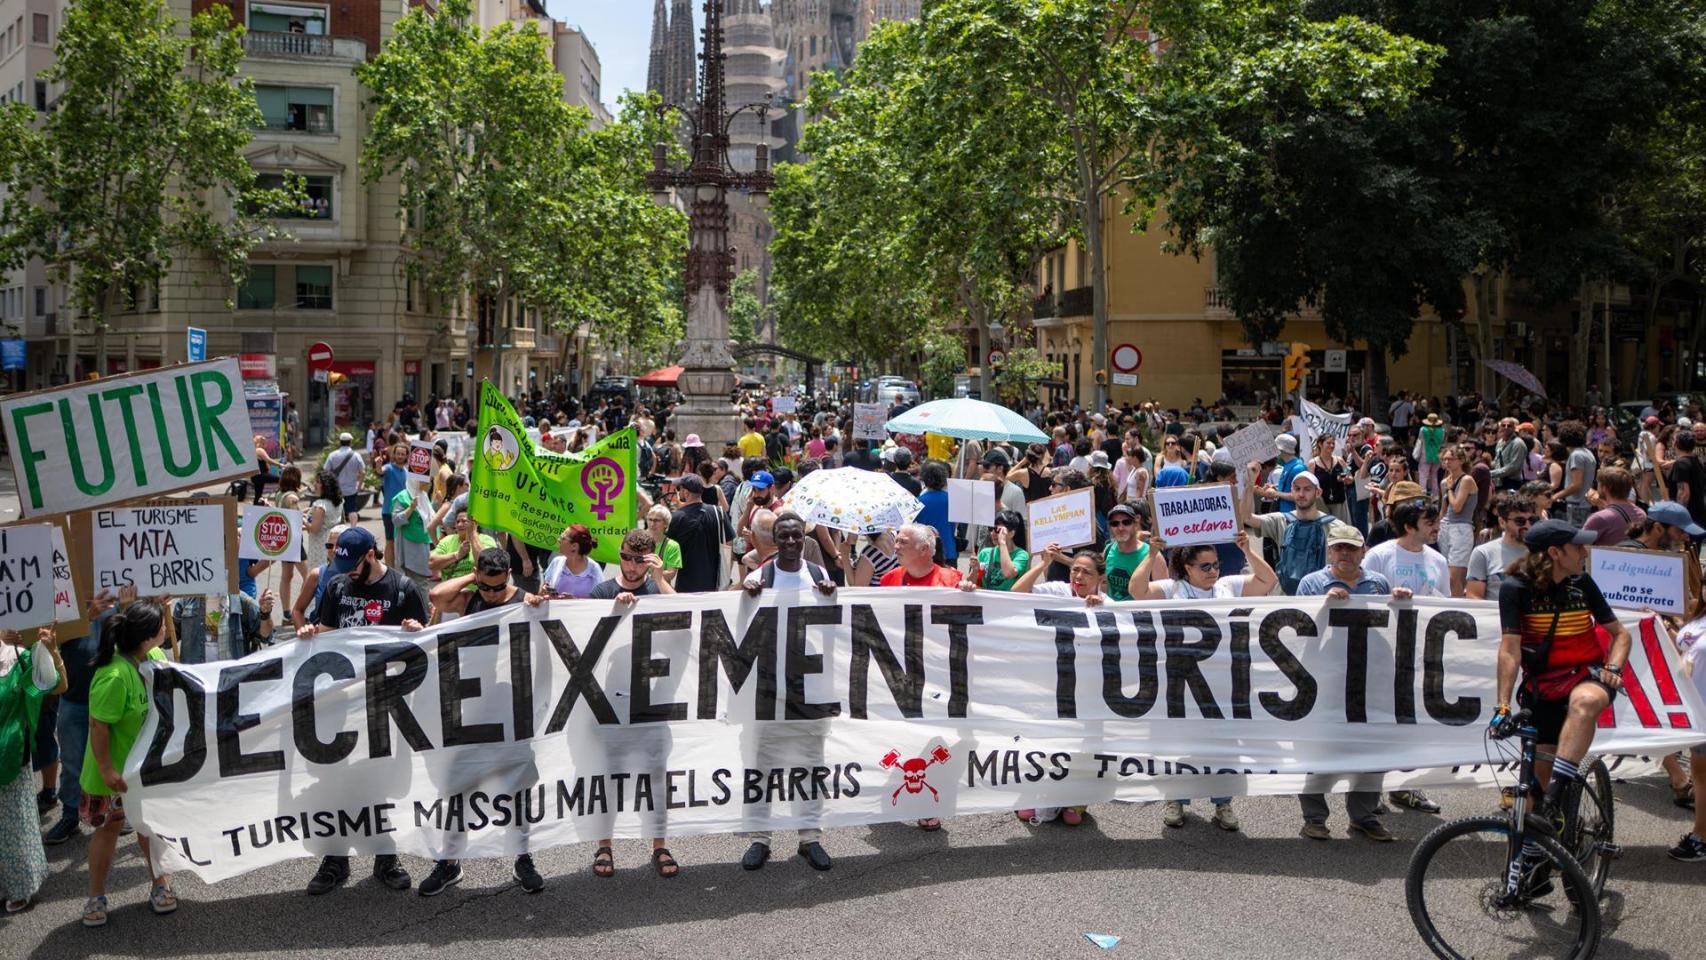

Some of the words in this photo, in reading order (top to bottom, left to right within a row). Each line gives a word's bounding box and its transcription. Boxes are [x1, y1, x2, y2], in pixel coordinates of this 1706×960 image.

[11, 370, 246, 509] FUTUR
[1159, 495, 1231, 517] TRABAJADORAS,
[99, 511, 126, 529] EL
[131, 507, 199, 527] TURISME
[261, 522, 288, 535] STOP
[1165, 525, 1180, 537] no
[1183, 518, 1234, 534] esclavas
[119, 529, 180, 561] MATA
[100, 567, 135, 588] ELS
[150, 557, 214, 588] BARRIS
[1600, 560, 1616, 571] La
[1618, 562, 1673, 577] dignidad
[1603, 591, 1675, 607] subcontrata
[1622, 585, 1637, 593] no
[140, 604, 983, 786] DECREIXEMENT
[1034, 607, 1482, 727] TURÍSTIC
[967, 750, 1072, 788] MASS
[222, 803, 397, 857] TURISME
[413, 783, 546, 832] MASSIU
[556, 772, 655, 819] MATA
[665, 768, 732, 809] ELS
[742, 761, 863, 804] BARRIS
